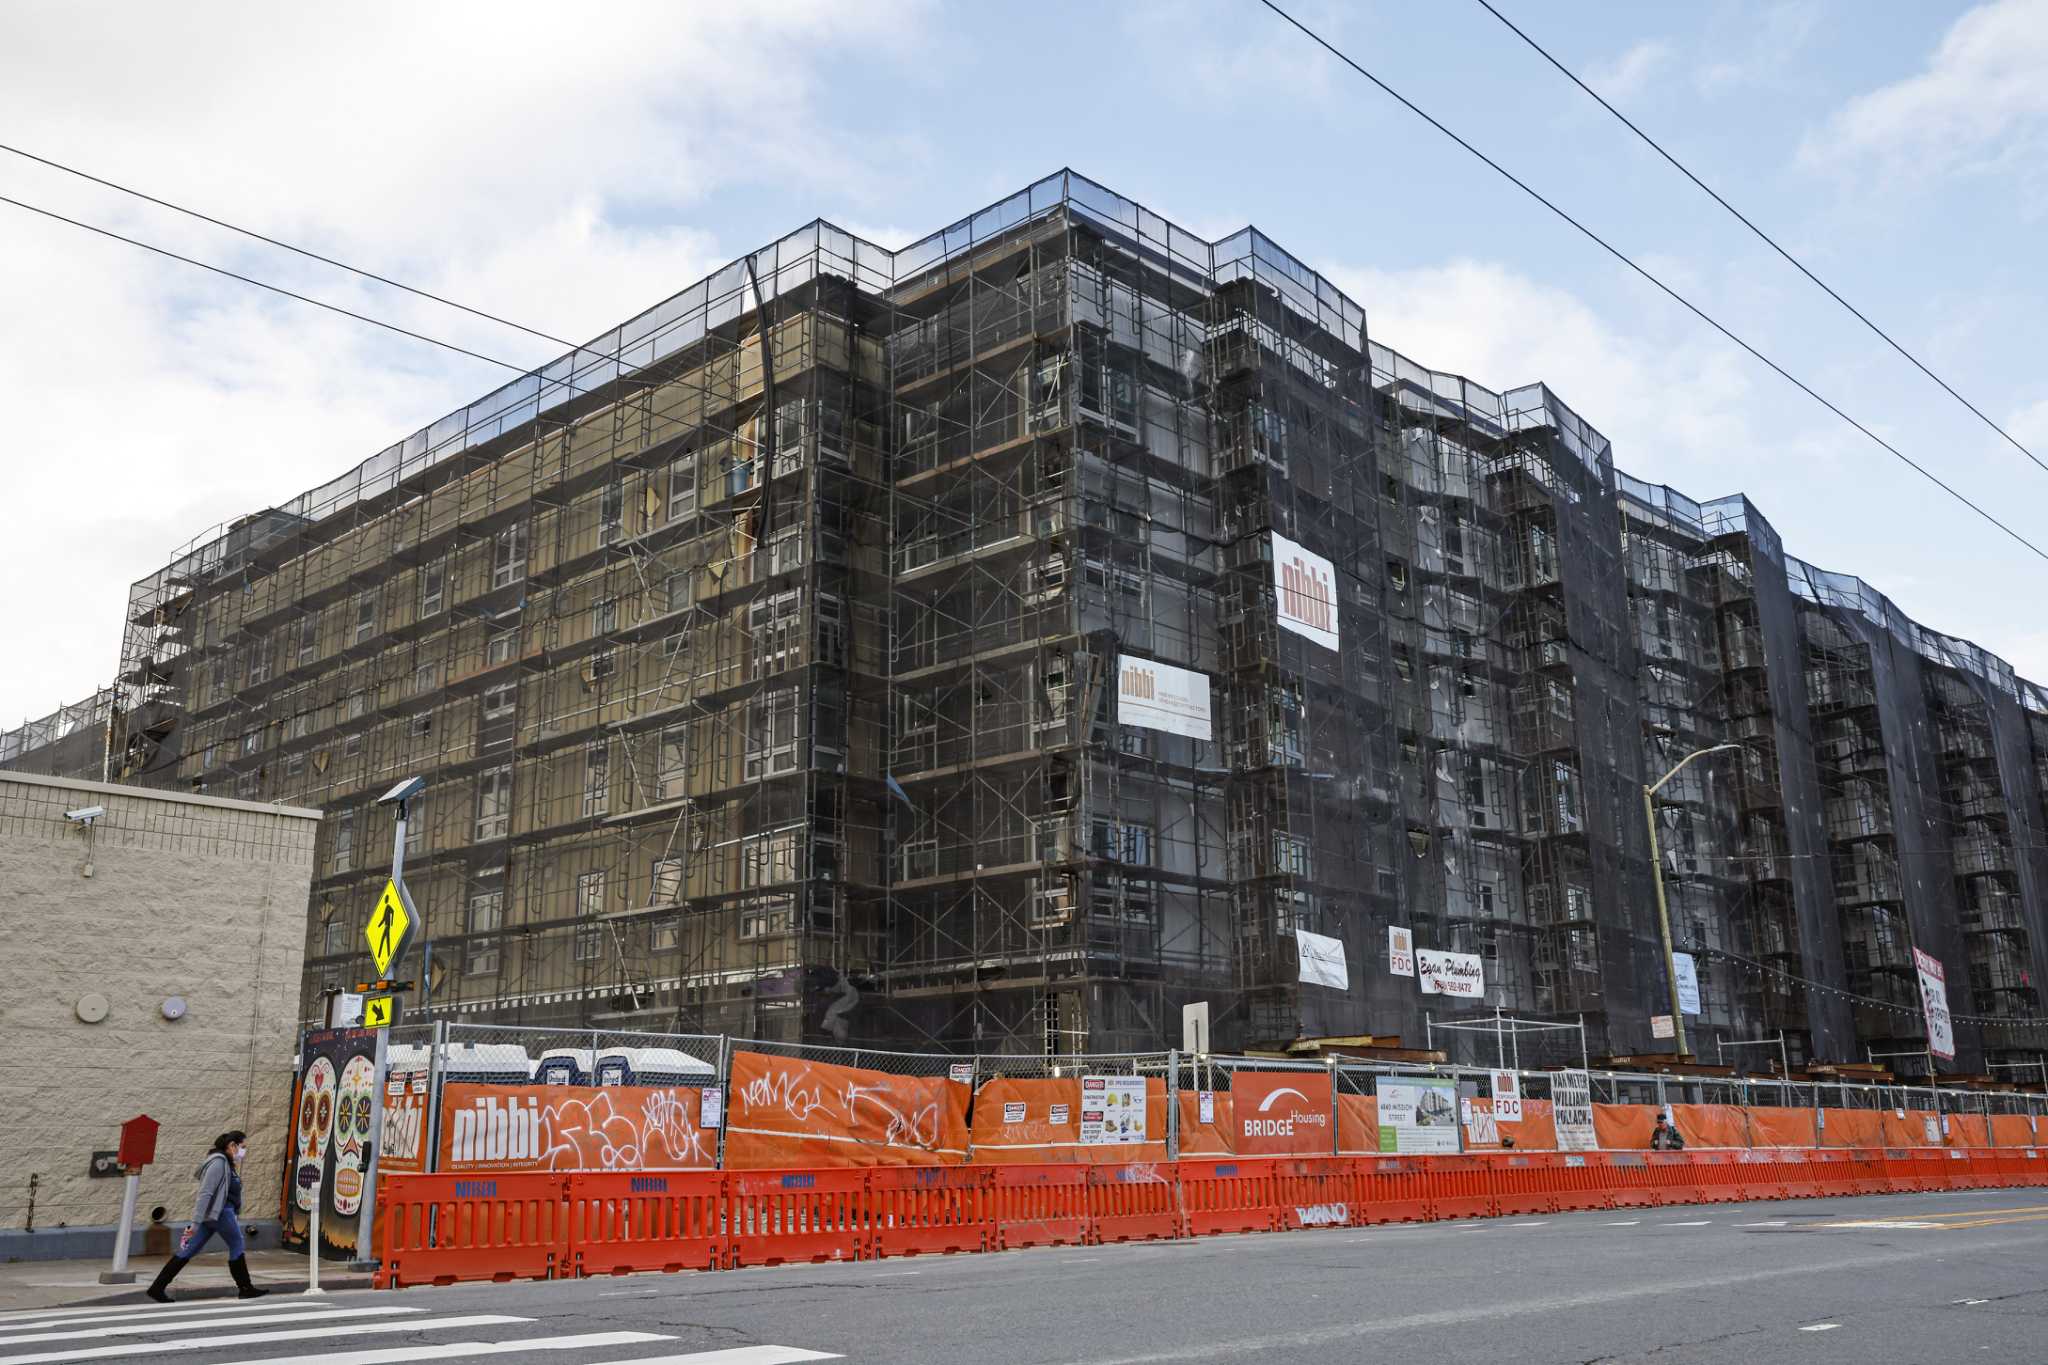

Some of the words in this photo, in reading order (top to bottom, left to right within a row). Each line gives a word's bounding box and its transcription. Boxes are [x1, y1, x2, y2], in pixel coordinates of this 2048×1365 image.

[1281, 556, 1331, 632] nibbi
[1121, 664, 1155, 701] nibbi
[1391, 956, 1412, 972] FDC
[1420, 956, 1442, 977] Egan
[1444, 958, 1481, 984] Plumbing
[1291, 1109, 1325, 1127] Housing
[1495, 1100, 1519, 1115] FDC
[451, 1096, 539, 1162] nibbi
[1244, 1119, 1294, 1137] BRIDGE
